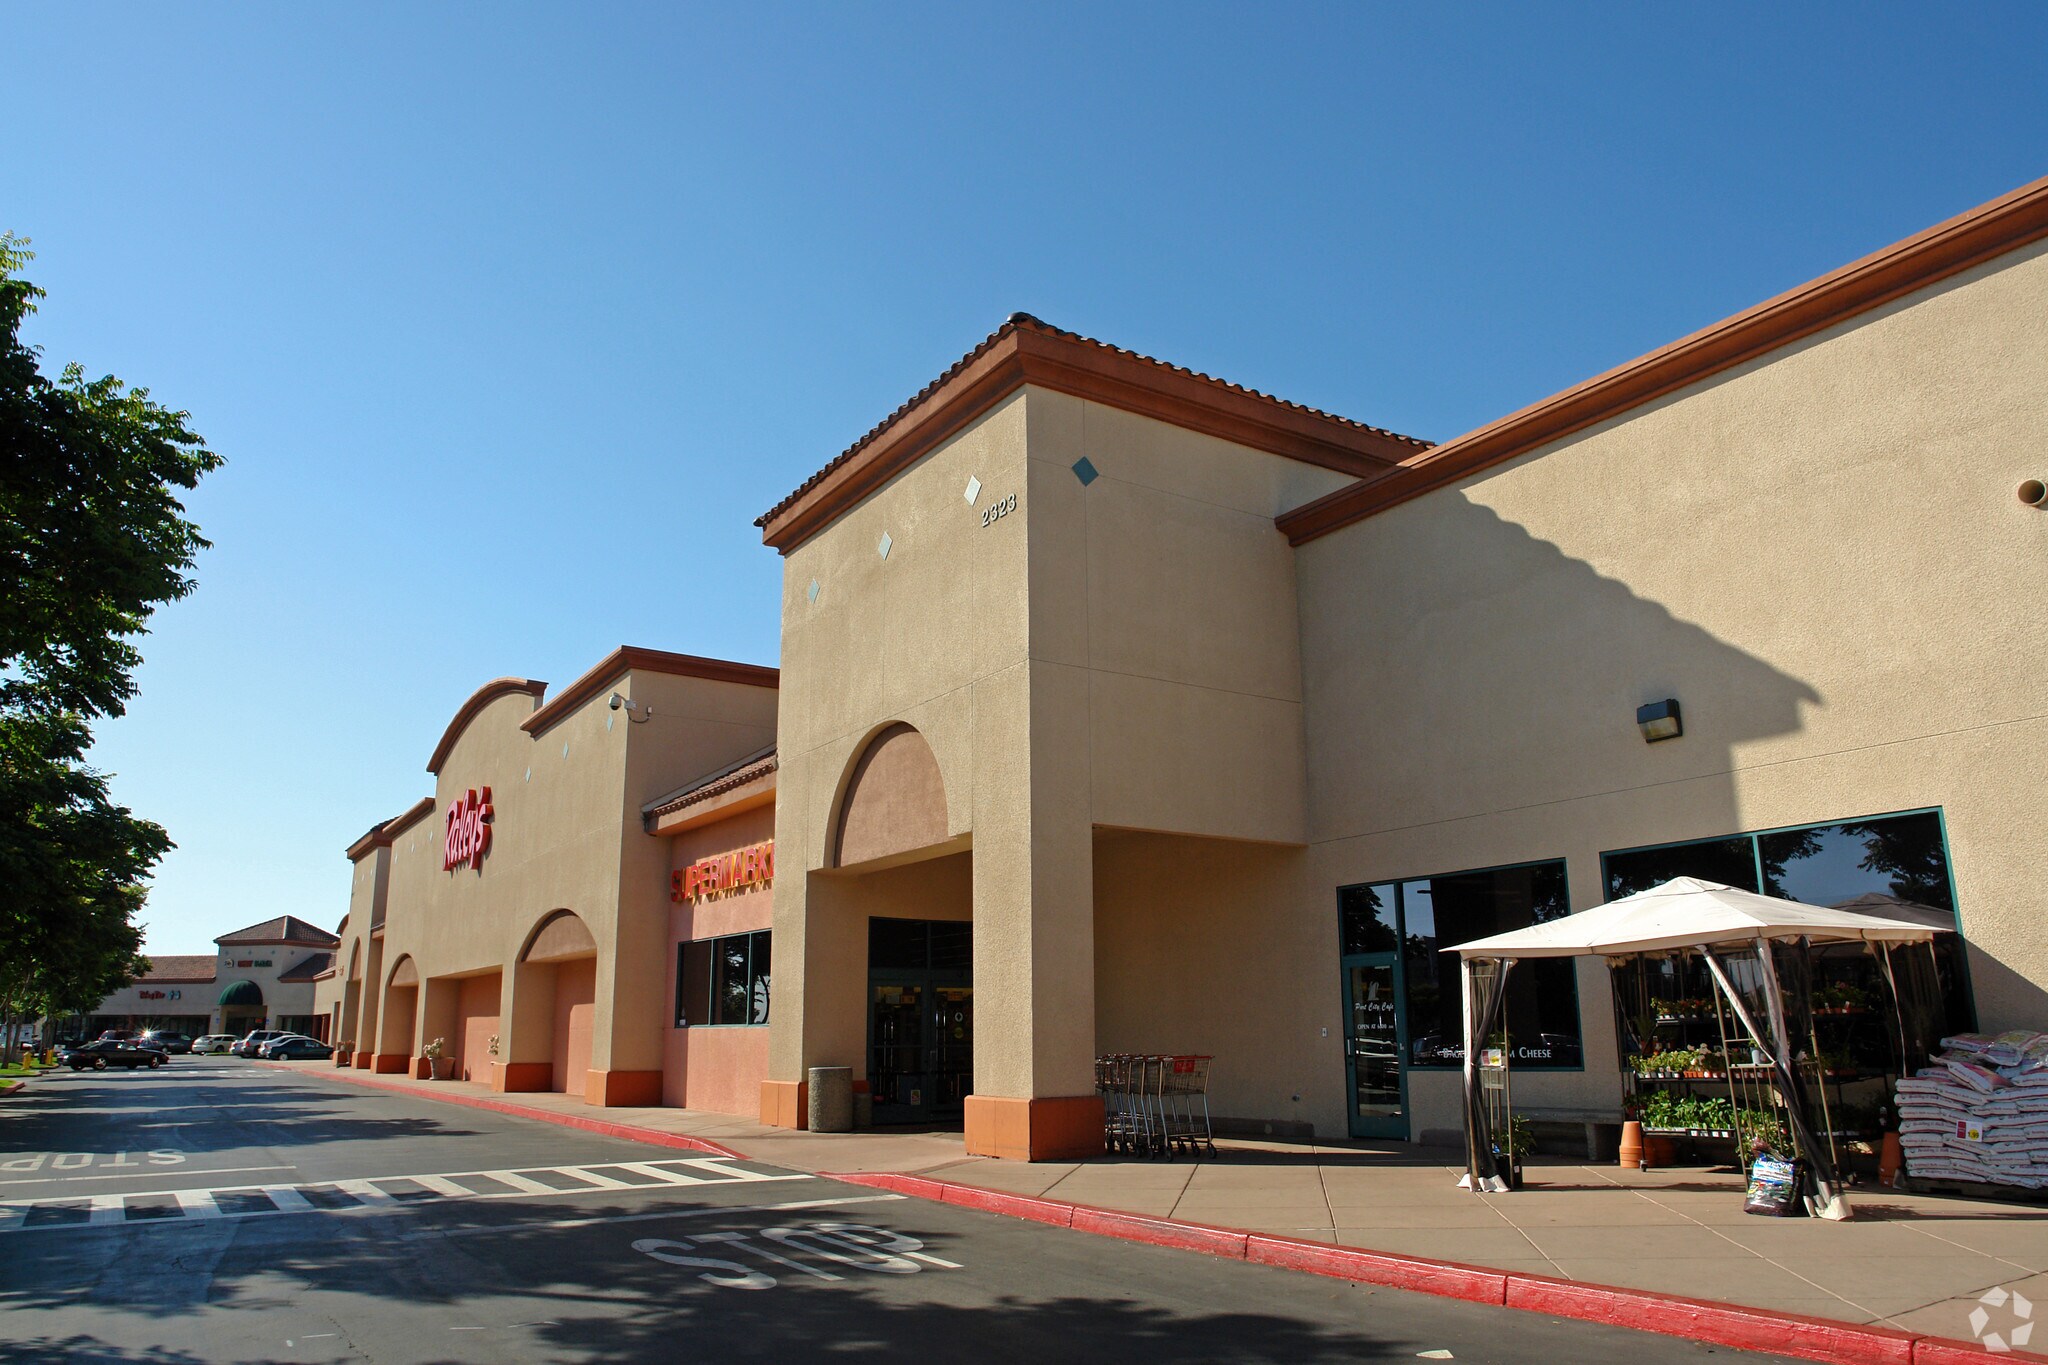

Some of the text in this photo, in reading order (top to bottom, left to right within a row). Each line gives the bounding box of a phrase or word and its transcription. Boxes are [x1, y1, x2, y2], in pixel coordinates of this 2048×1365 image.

[982, 493, 1017, 528] 2323
[443, 785, 494, 871] Raley's
[1368, 1002, 1380, 1011] City
[1519, 1047, 1552, 1059] CHEESE
[0, 1148, 187, 1172] STOP
[631, 1223, 964, 1290] STOP
